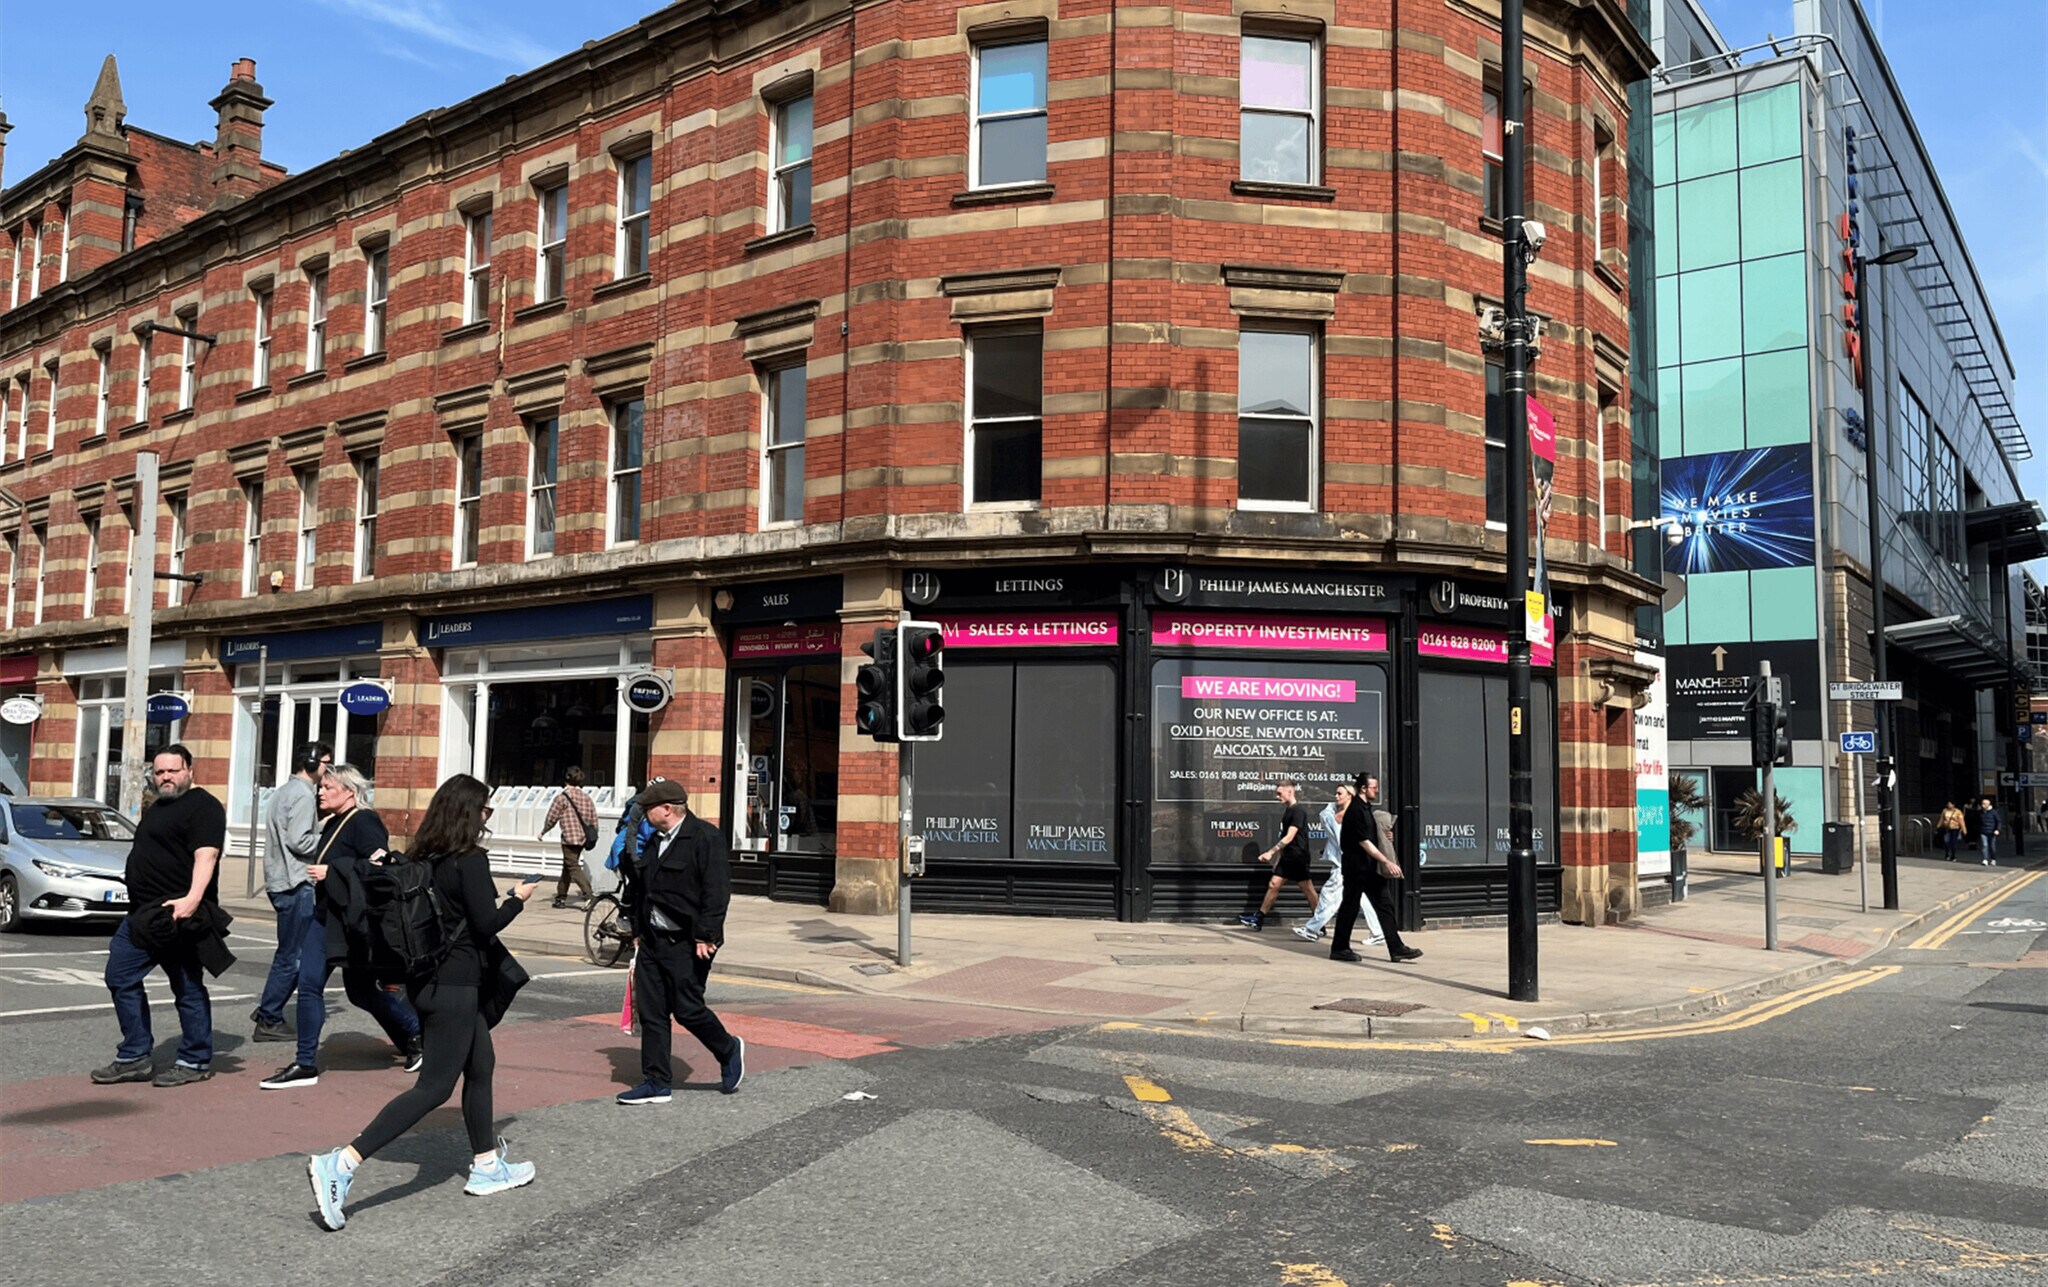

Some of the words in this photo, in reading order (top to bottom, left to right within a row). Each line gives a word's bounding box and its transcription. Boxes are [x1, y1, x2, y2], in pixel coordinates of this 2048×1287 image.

[1674, 498, 1698, 509] WE
[1708, 491, 1757, 507] MAKE
[1681, 508, 1751, 523] MOVIES
[1685, 522, 1747, 537] BETTER
[995, 579, 1064, 593] LETTINGS
[1200, 579, 1245, 592] PHILIP
[1247, 581, 1289, 595] JAMES
[1291, 582, 1386, 597] MANCHESTER
[763, 594, 789, 607] SALES
[1459, 593, 1503, 609] PROPERTY
[440, 622, 472, 633] LEADERS
[968, 623, 1014, 636] SALES
[1018, 623, 1029, 636] &
[1034, 622, 1108, 636] LETTINGS
[1171, 622, 1255, 637] PROPERTY
[1259, 625, 1370, 641] INVESTMENTS
[236, 642, 260, 651] LEADERS
[1422, 632, 1447, 647] 0161
[1450, 635, 1469, 649] 828
[1471, 637, 1496, 652] 8200
[1195, 680, 1224, 695] WE
[1227, 680, 1260, 696] ARE
[1265, 682, 1341, 698] MOVING!
[1675, 676, 1750, 689] MANCH235T
[1830, 683, 1840, 691] GT
[1843, 682, 1900, 691] BRIDGEWATER
[1194, 708, 1222, 720] OUR
[1225, 708, 1257, 720] NEW
[1258, 709, 1304, 722] OFFICE
[1306, 710, 1317, 722] IS
[1319, 710, 1338, 722] AT:
[1170, 725, 1203, 738] OXID
[1206, 726, 1253, 739] HOUSE,
[1256, 727, 1314, 739] NEWTON
[1317, 728, 1364, 741] STREET,
[1213, 744, 1276, 757] ANCOATS,
[1279, 745, 1298, 757] M1
[1302, 745, 1325, 757] 1AL
[1169, 770, 1197, 779] SALES:
[1199, 771, 1220, 779] 0161
[1221, 771, 1237, 780] 828
[1238, 771, 1260, 780] 8202
[1264, 771, 1306, 781] LETTINGS:
[1307, 772, 1328, 781] 0161
[1329, 773, 1346, 781] 828
[925, 817, 960, 829] PHILIP
[961, 817, 998, 831] JAMES
[1211, 821, 1234, 830] PHILIP
[1235, 821, 1260, 831] JAMES
[922, 830, 1000, 843] MANCHESTER
[1030, 824, 1065, 838] PHILIP
[1067, 826, 1106, 840] JAMES
[1217, 830, 1254, 838] LETTINGS
[1425, 824, 1449, 836] PHILIP
[1450, 824, 1476, 839] JAMES
[1026, 838, 1107, 852] MANCHESTER
[1423, 838, 1477, 850] MANCHESTER
[330, 1179, 338, 1204] HOKA
